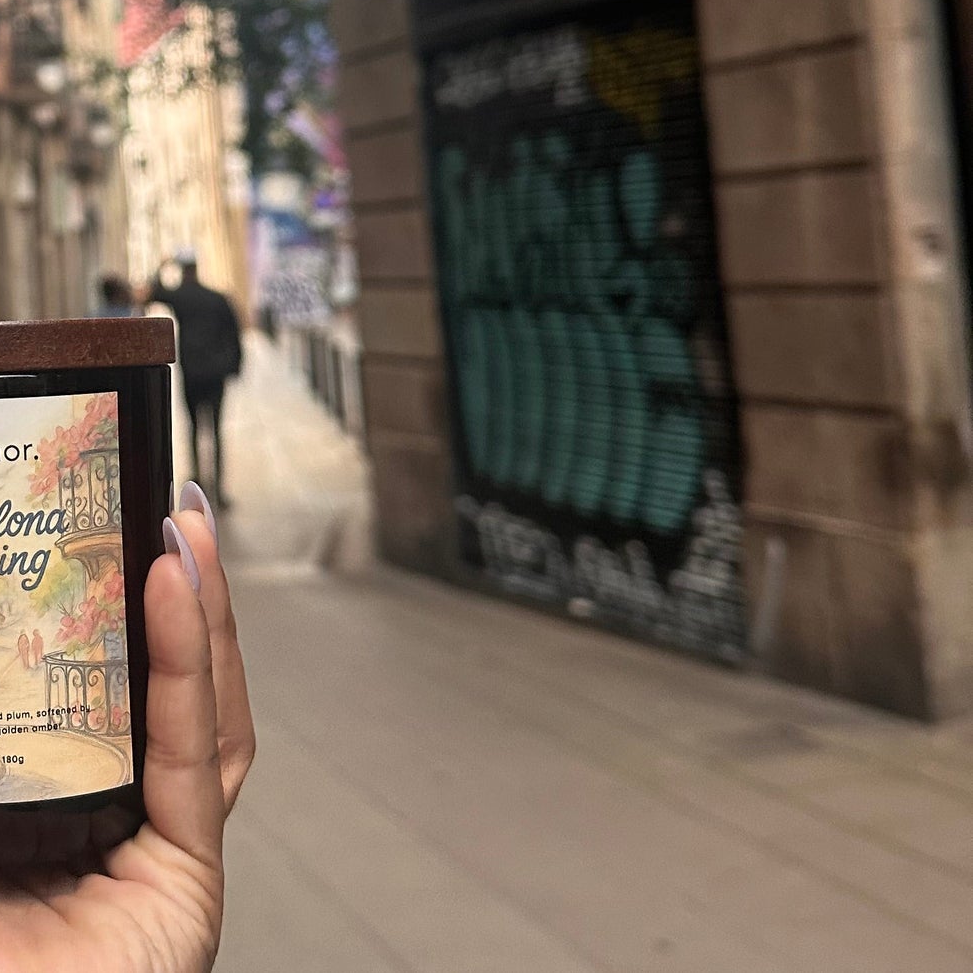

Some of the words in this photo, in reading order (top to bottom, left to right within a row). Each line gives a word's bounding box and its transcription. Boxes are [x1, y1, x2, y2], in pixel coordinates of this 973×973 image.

[6, 711, 33, 721] plum,
[36, 705, 77, 718] softened
[80, 705, 91, 713] by
[2, 755, 25, 764] 180g
